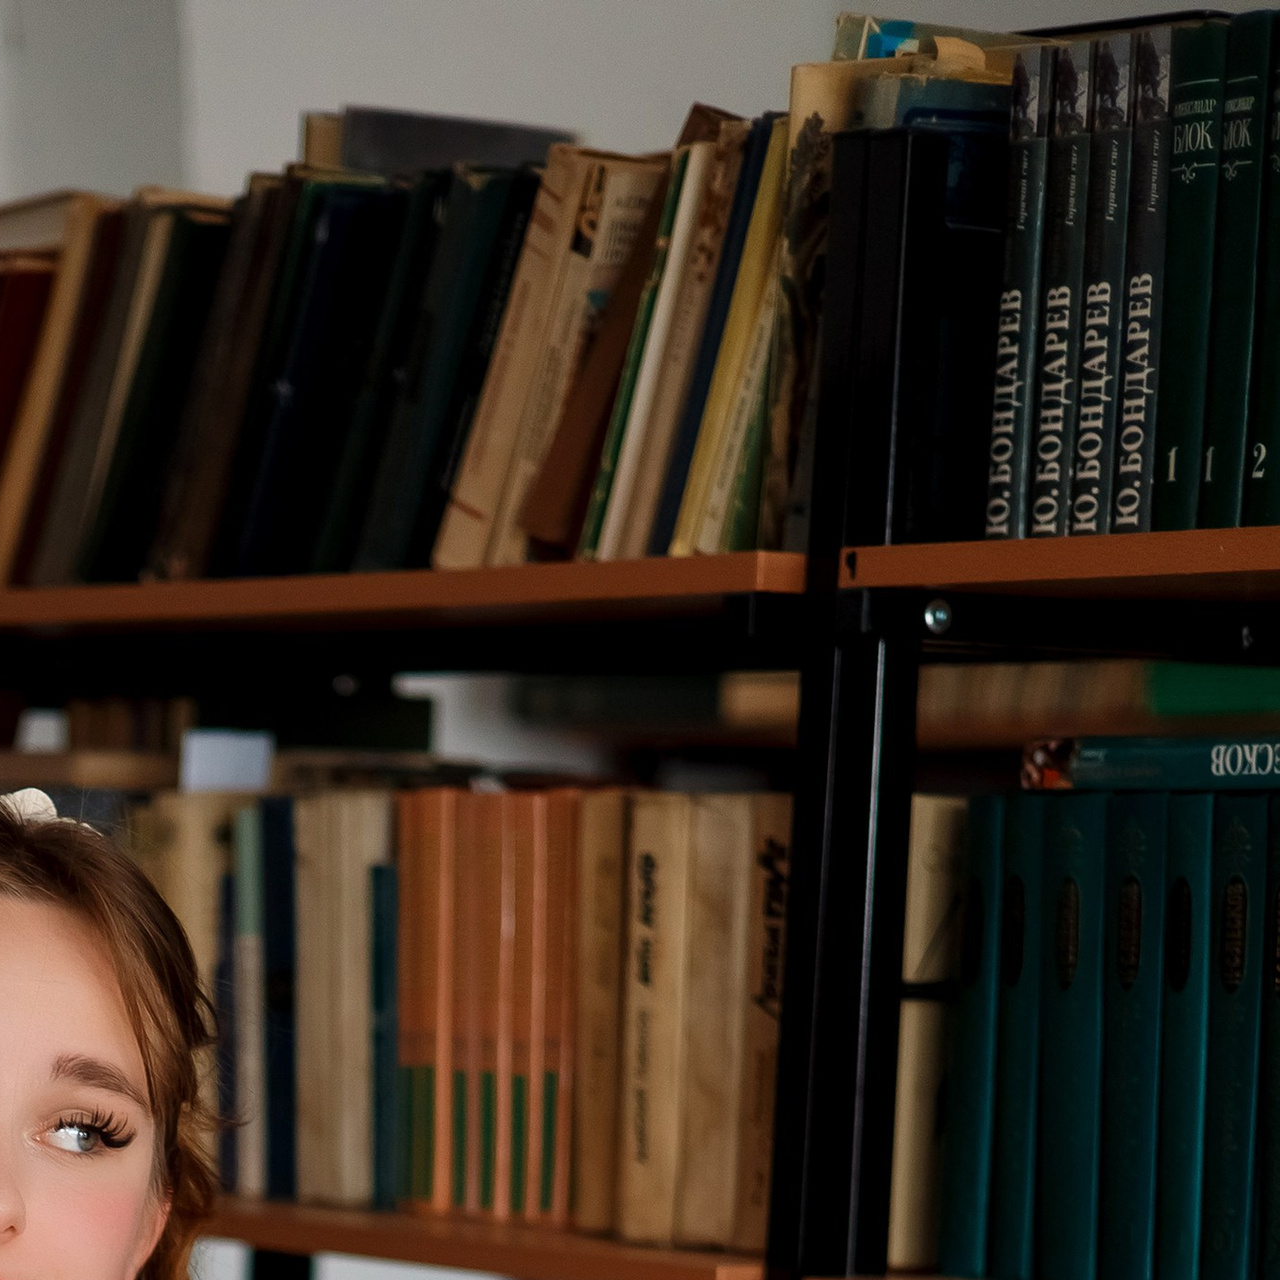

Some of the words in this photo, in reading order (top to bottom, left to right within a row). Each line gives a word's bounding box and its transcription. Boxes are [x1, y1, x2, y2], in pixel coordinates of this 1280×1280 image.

[1173, 120, 1214, 154] БЛОК
[988, 288, 1023, 485] БОНДАРЕВ
[1035, 285, 1073, 483] БОНДАРЕВ
[1075, 280, 1113, 481] БОНДАРЕВ
[1118, 272, 1155, 474] БОНДАРЕВ
[1166, 446, 1179, 482] 1
[1204, 446, 1215, 482] 1
[1252, 443, 1267, 479] 2
[985, 489, 1011, 535] Ю.
[1032, 488, 1060, 534] Ю.
[1072, 486, 1100, 533] Ю.
[1115, 478, 1141, 526] Ю.
